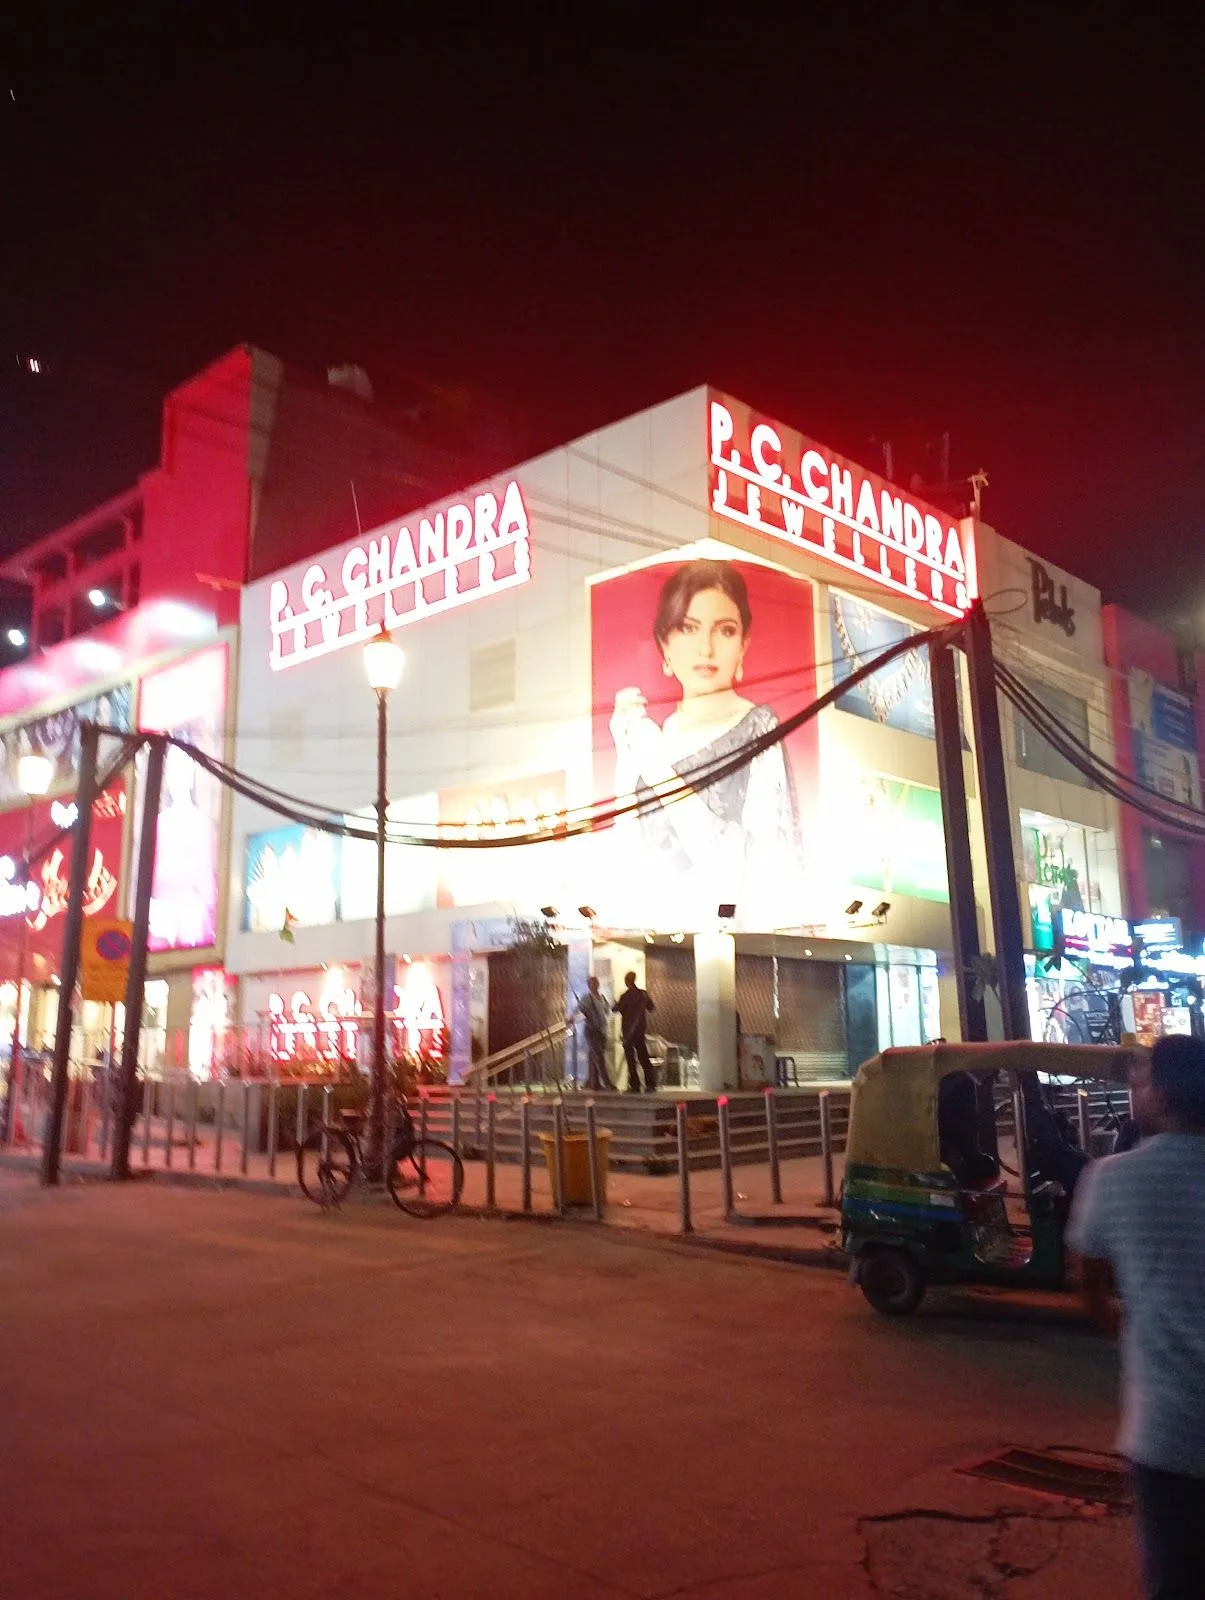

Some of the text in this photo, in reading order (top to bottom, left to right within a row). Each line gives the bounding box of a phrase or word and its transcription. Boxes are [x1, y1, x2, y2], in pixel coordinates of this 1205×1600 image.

[341, 480, 530, 595] CHANDRA
[711, 401, 966, 575] P. C. CHANDRA
[712, 470, 972, 609] JEWELLERS
